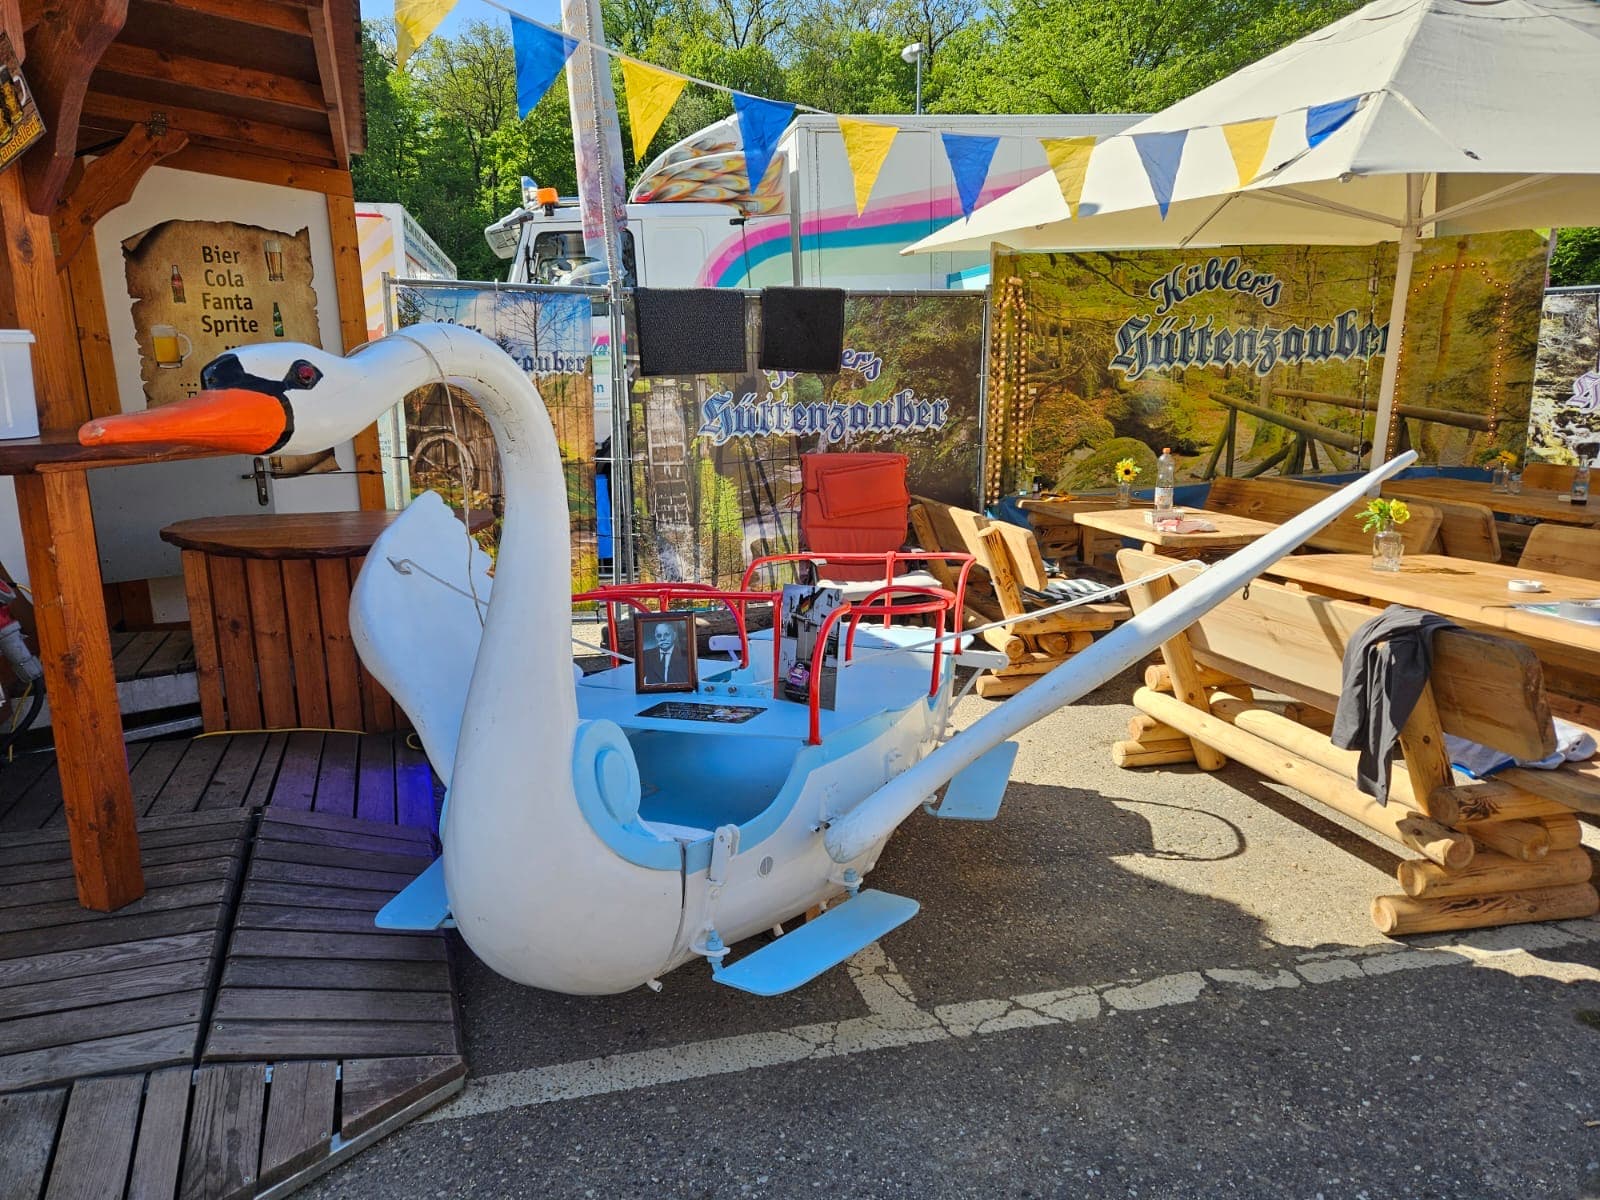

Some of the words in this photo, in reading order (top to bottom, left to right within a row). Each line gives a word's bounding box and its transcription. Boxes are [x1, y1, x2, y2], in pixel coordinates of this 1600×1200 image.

[202, 246, 240, 264] Bier
[204, 269, 244, 288] Cola
[202, 292, 254, 311] Fanta
[201, 315, 259, 337] Sprite
[698, 389, 951, 444] Hüttenzauber
